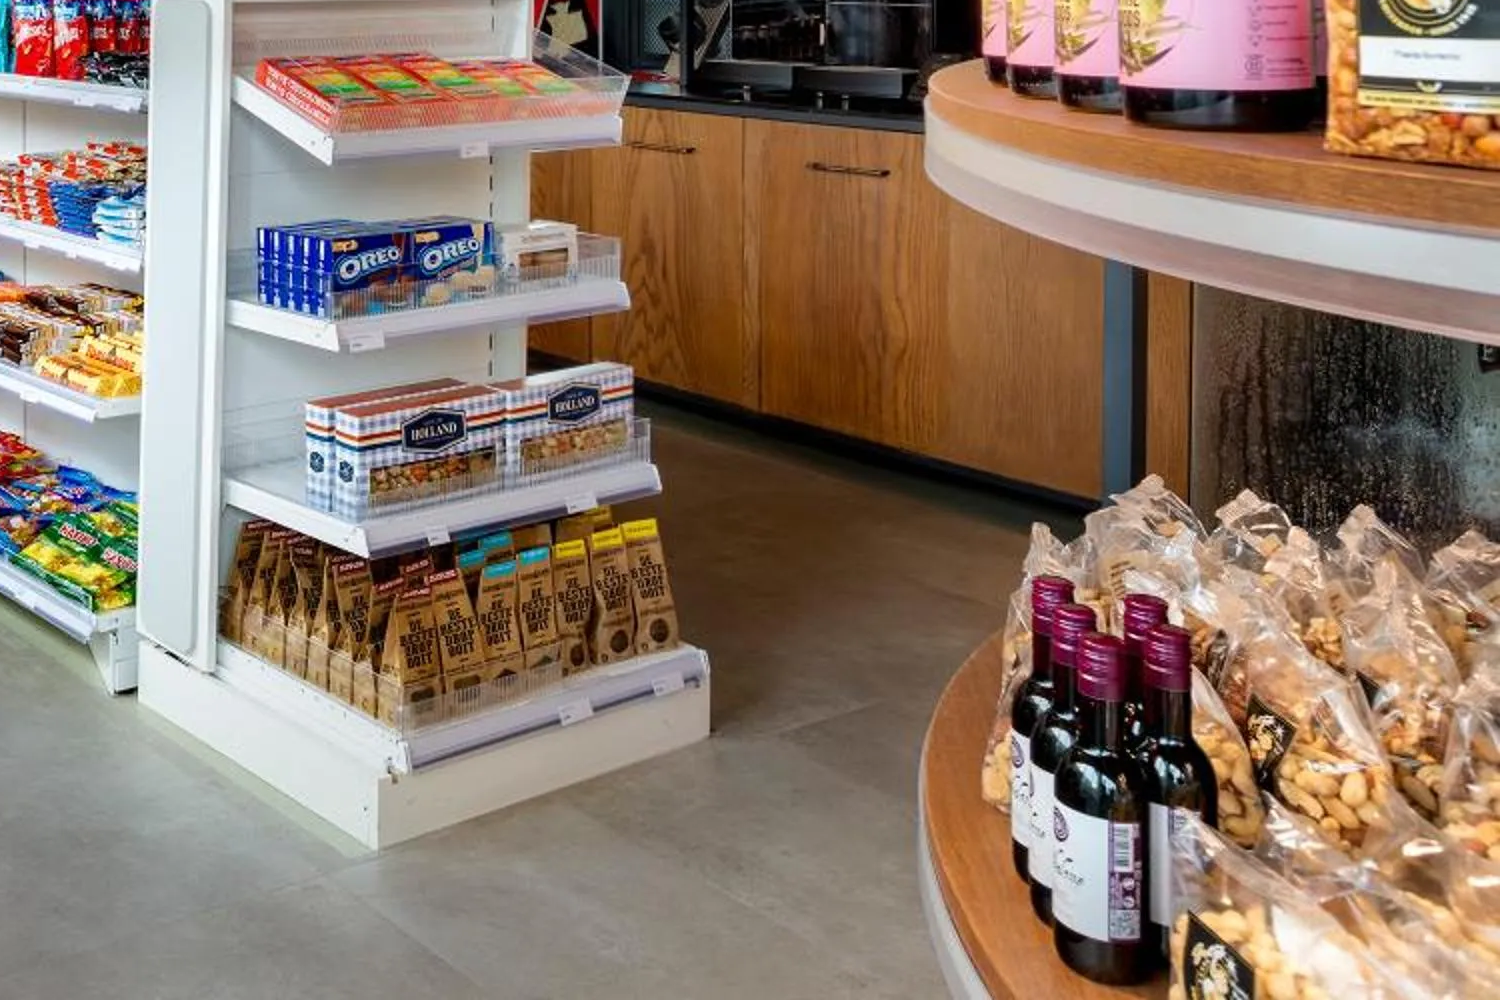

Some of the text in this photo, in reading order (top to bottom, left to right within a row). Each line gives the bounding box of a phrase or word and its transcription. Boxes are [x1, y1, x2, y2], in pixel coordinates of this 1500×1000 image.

[339, 245, 400, 281] OREO
[423, 238, 479, 270] OREO
[555, 394, 595, 414] HOLLAND
[411, 422, 457, 442] HOLLAND
[630, 564, 663, 579] BESTE
